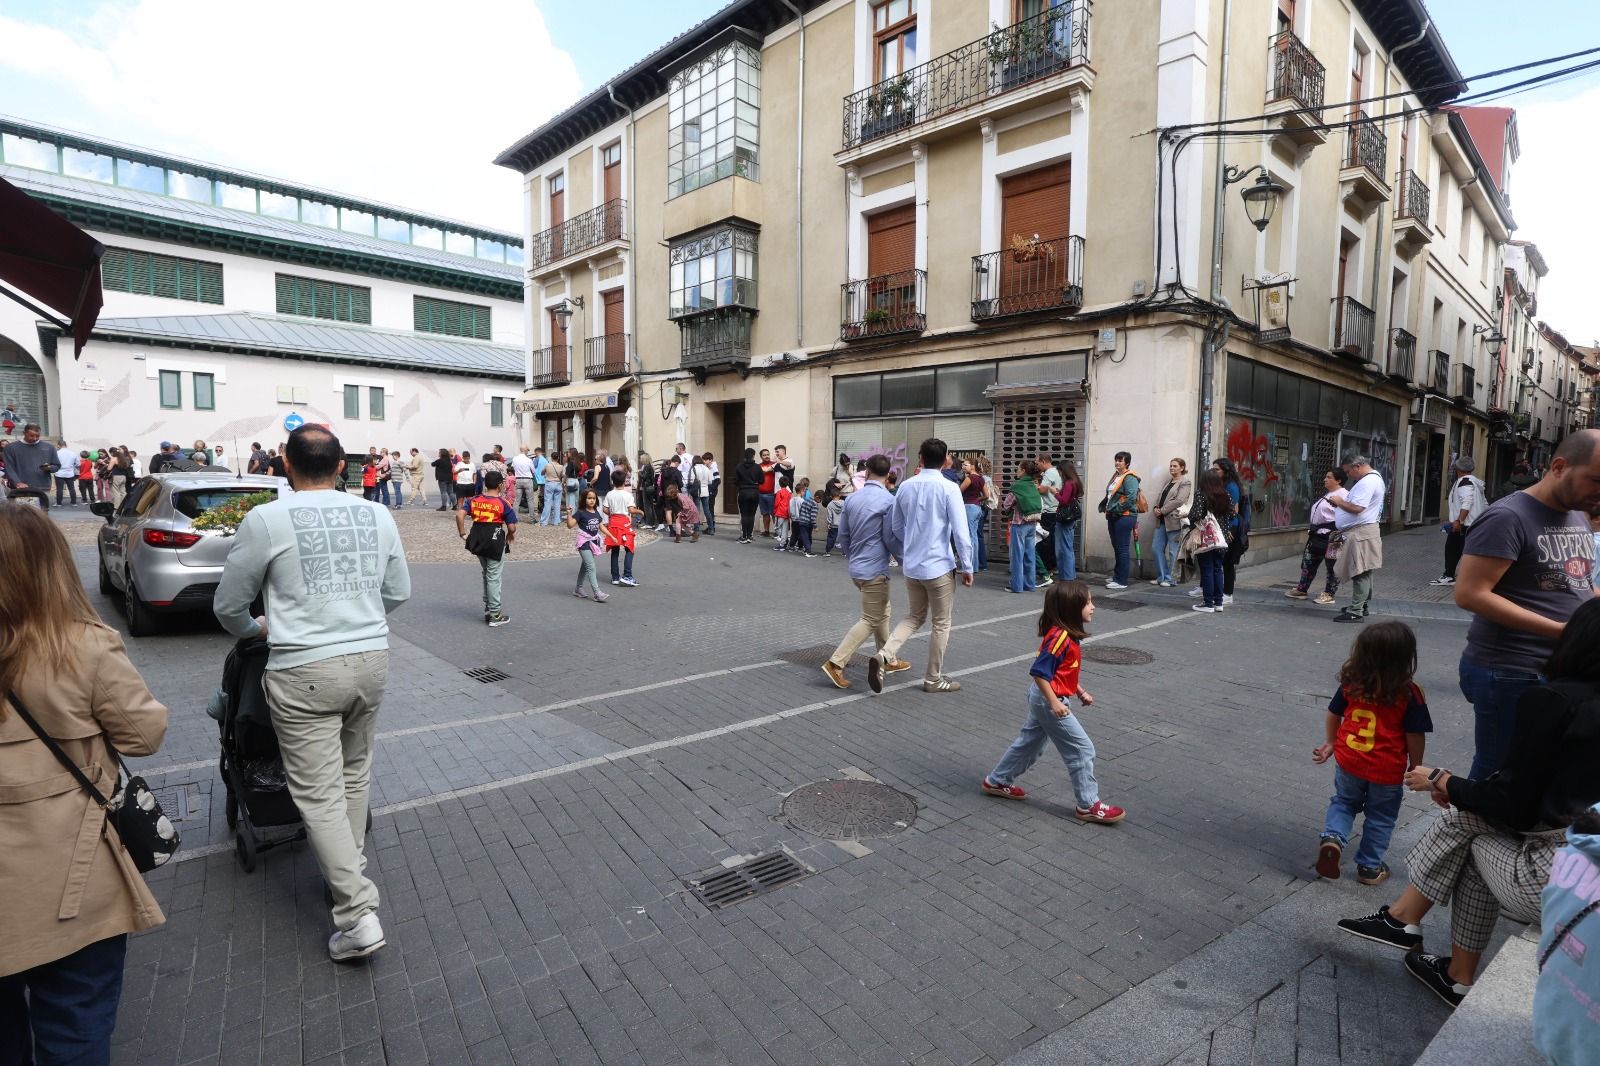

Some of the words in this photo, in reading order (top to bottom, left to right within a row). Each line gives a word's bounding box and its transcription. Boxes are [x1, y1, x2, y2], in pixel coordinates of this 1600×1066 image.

[522, 402, 541, 412] TASCA
[542, 401, 551, 410] LA
[552, 399, 590, 410] RINCONADA
[1346, 708, 1377, 752] 3
